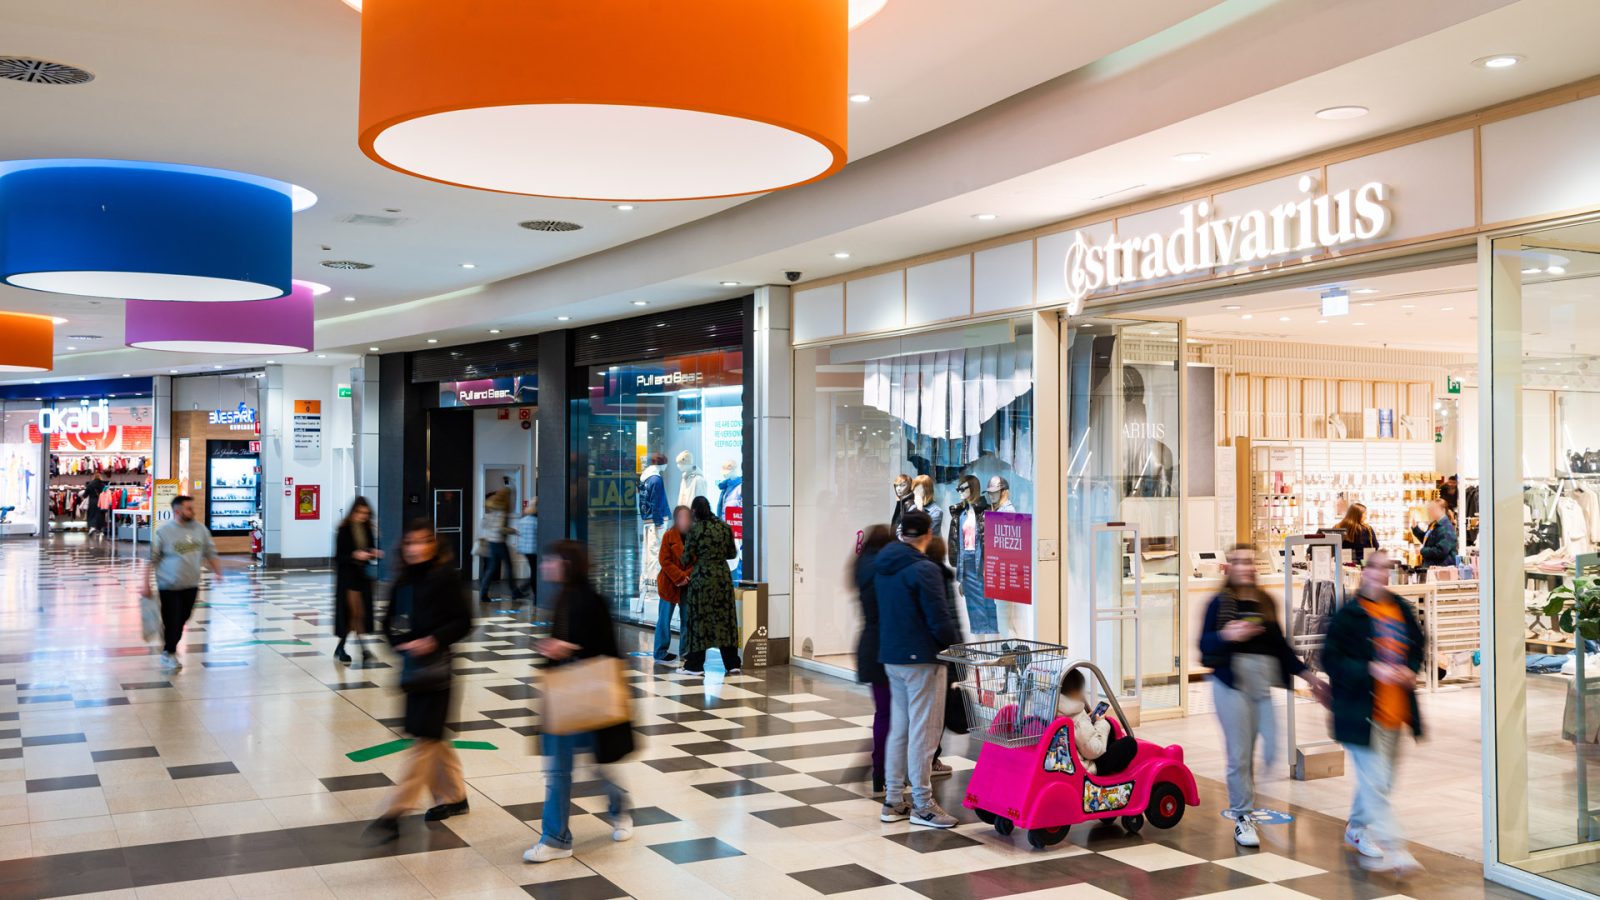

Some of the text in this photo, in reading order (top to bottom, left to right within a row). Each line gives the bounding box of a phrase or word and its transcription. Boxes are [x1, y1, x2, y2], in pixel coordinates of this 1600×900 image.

[1084, 174, 1392, 291] stradivarius
[636, 374, 654, 387] Pull
[459, 390, 473, 401] Pull
[488, 388, 510, 399] Bear
[994, 523, 1022, 538] ULTIMI
[993, 536, 1022, 551] PREZZI
